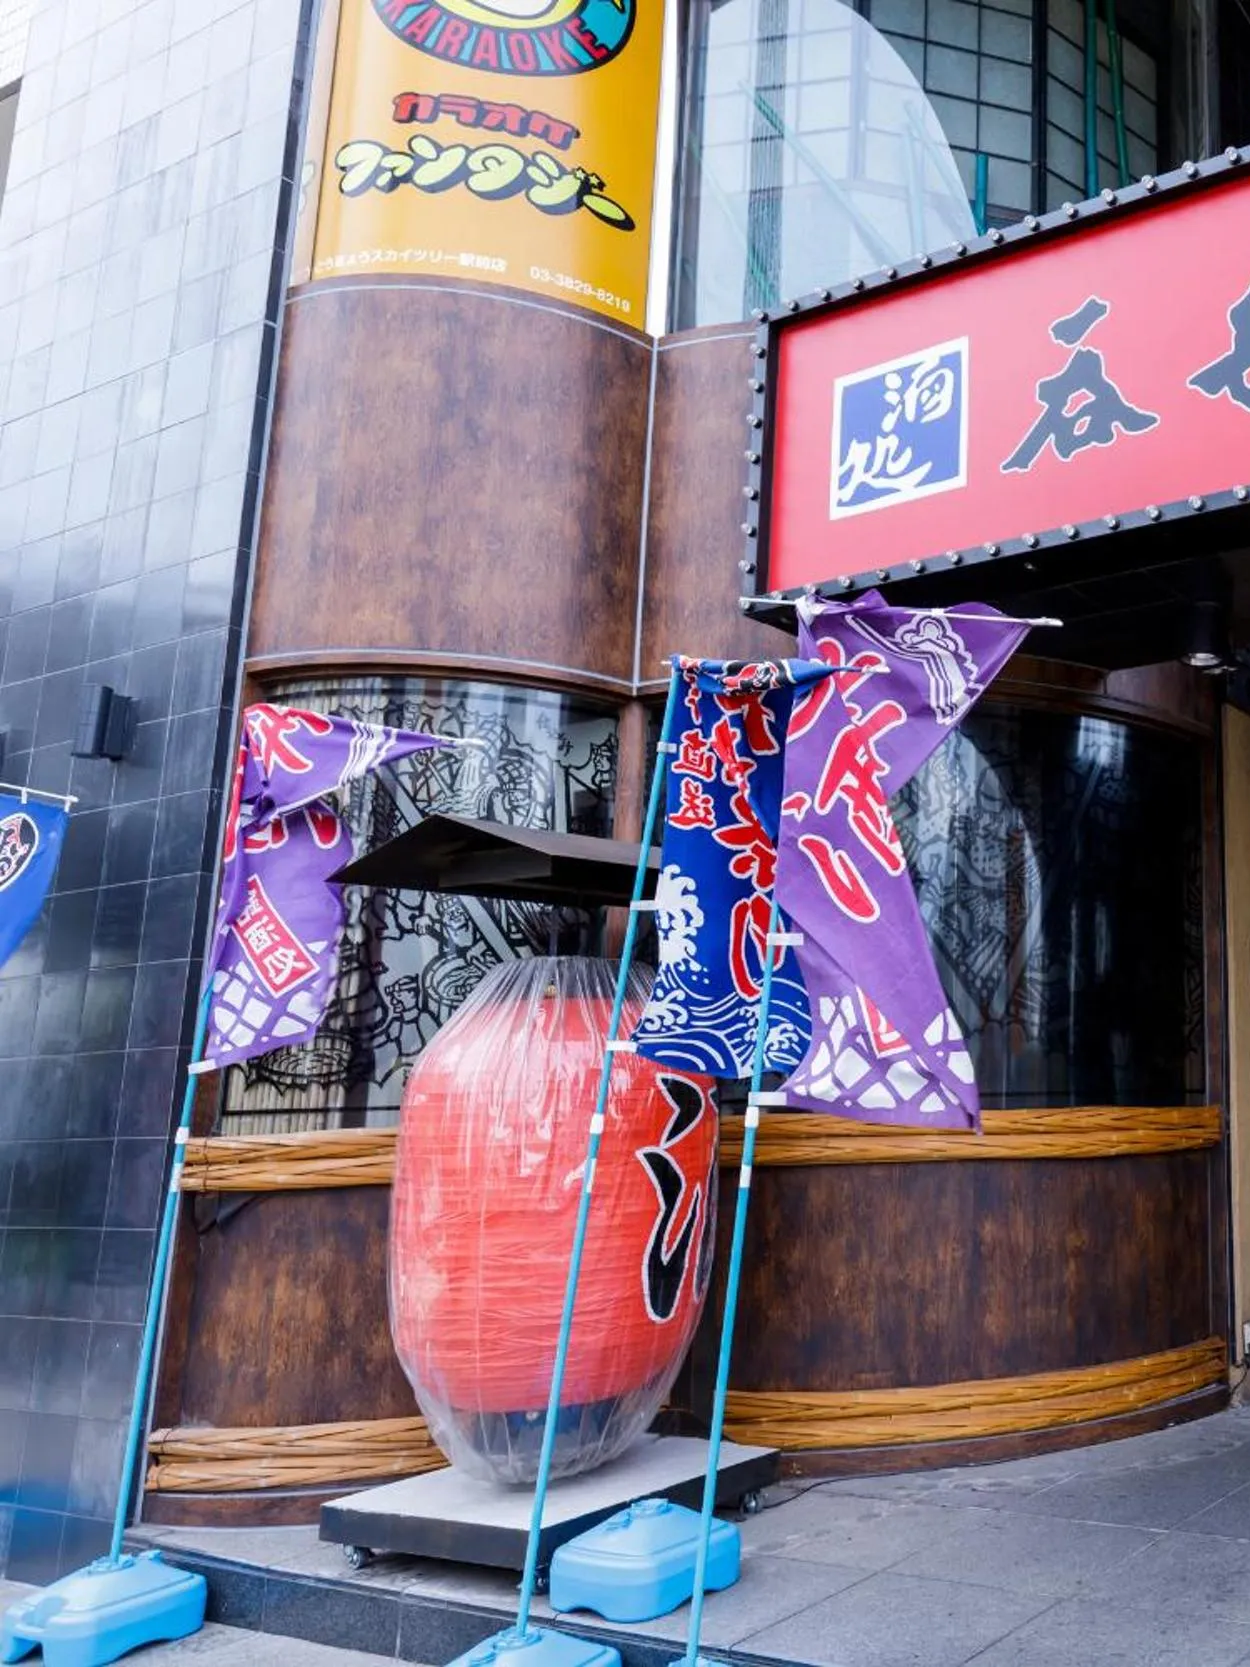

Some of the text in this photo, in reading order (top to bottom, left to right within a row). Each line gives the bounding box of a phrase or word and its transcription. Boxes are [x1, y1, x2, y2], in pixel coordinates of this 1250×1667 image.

[383, 0, 609, 72] KARAOKE
[393, 92, 580, 150] カラオケ
[335, 135, 636, 231] ファンタジー
